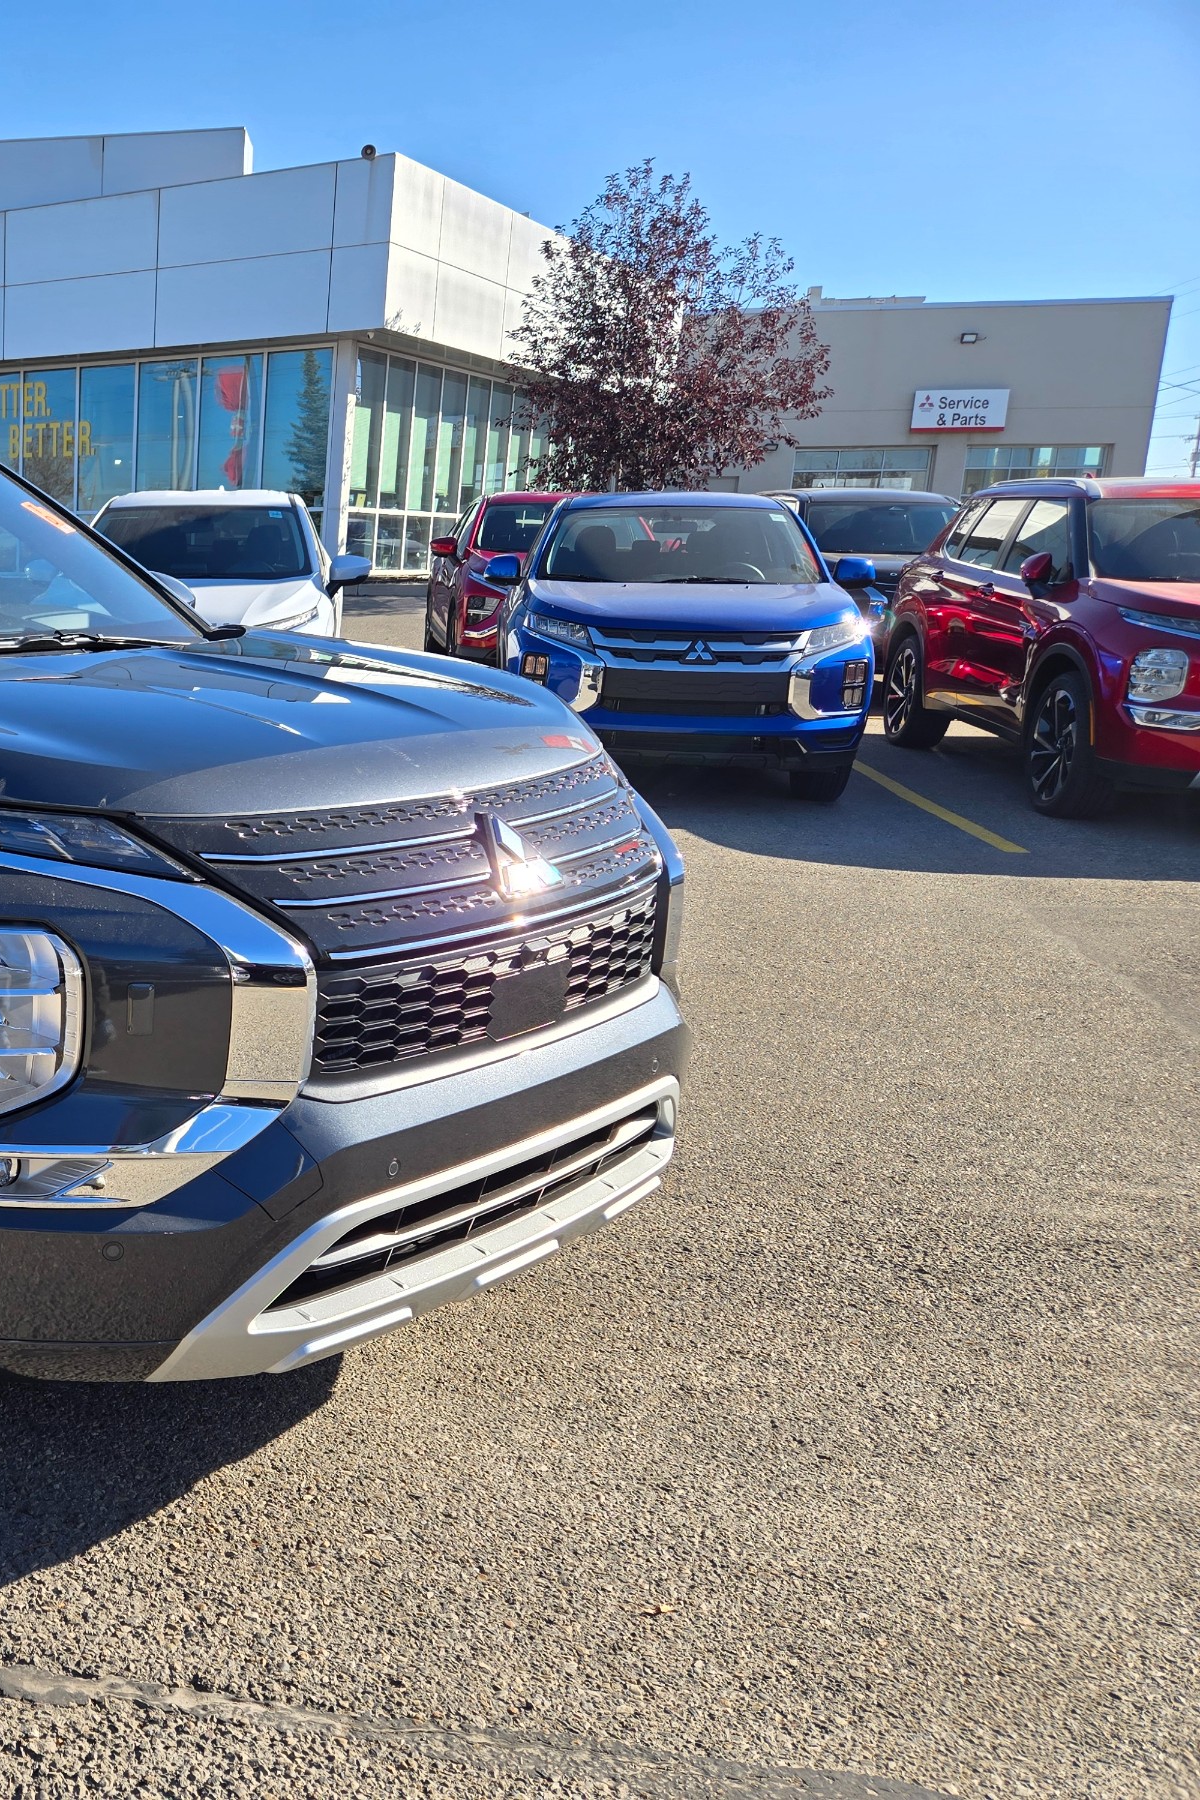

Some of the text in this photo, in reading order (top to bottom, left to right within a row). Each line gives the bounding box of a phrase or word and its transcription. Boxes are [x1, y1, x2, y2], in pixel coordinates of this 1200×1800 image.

[938, 396, 989, 410] Service
[936, 413, 986, 426] & Parts
[9, 421, 96, 459] BETTER.
